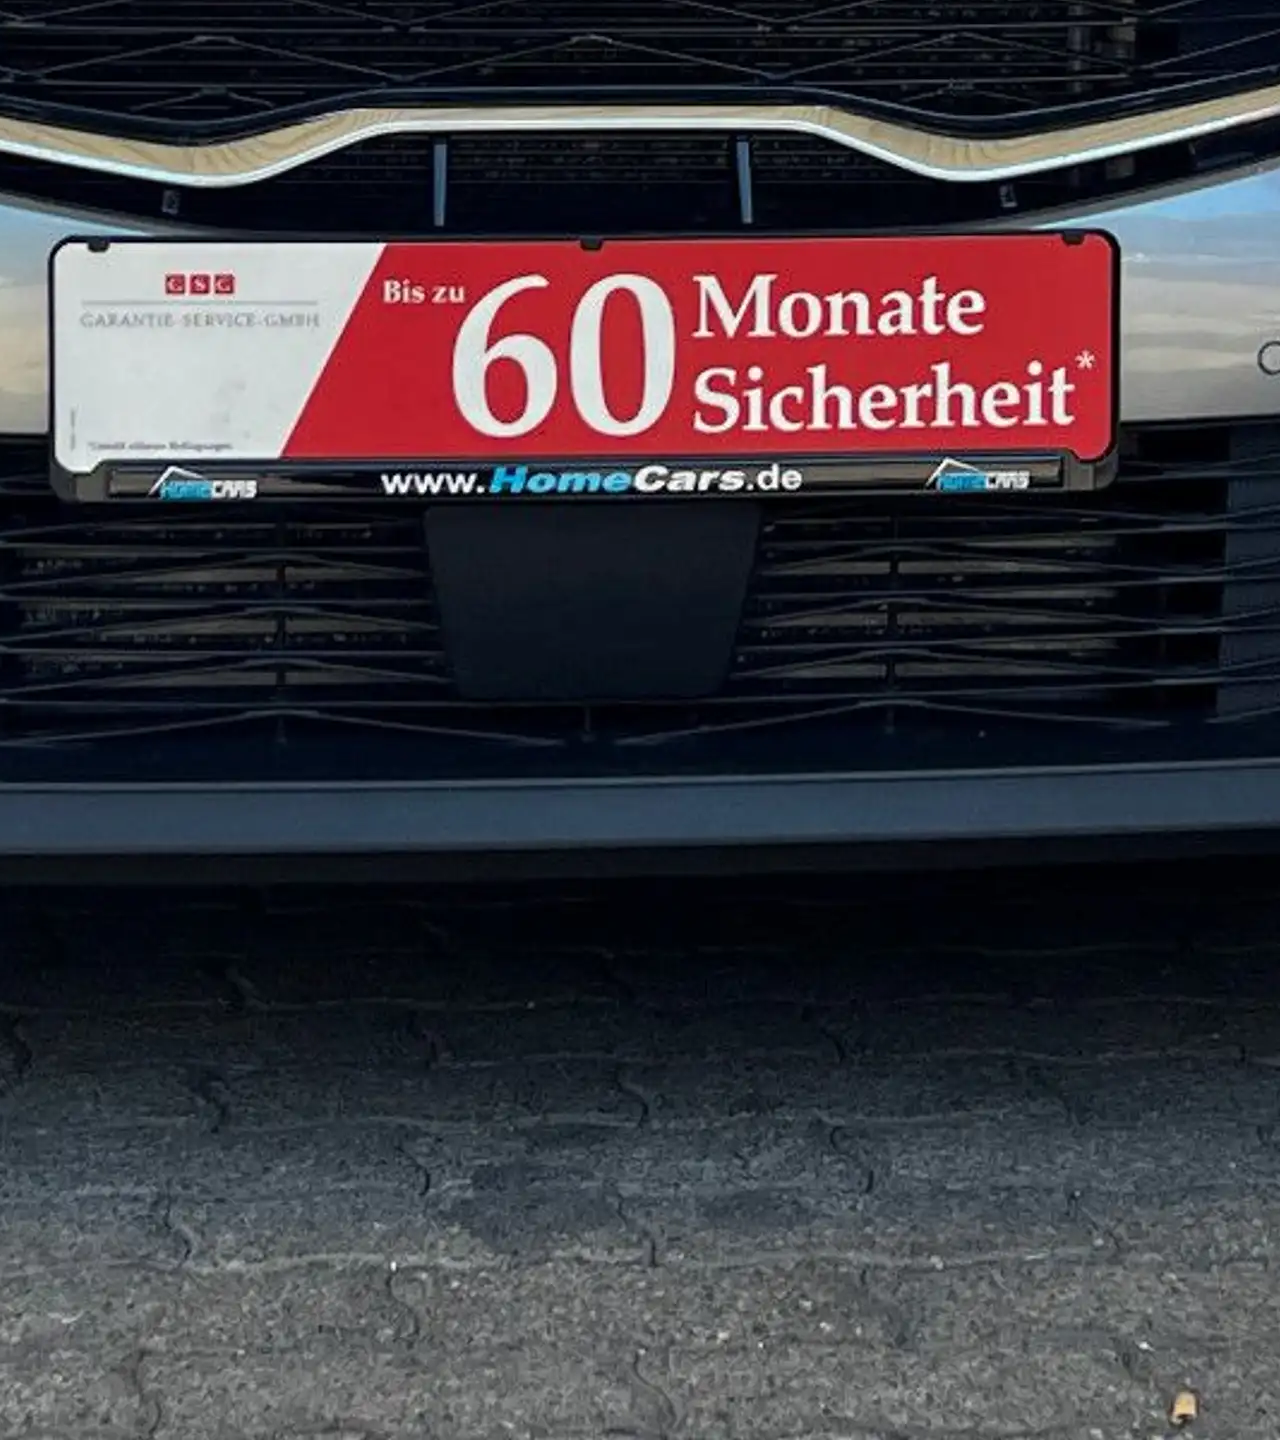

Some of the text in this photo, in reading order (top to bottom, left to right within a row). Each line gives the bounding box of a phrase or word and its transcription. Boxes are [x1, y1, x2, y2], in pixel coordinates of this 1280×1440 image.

[383, 279, 466, 304] Bis zu
[692, 273, 987, 339] Monate
[452, 273, 676, 439] 60
[380, 463, 804, 496] www.HomeCars.de
